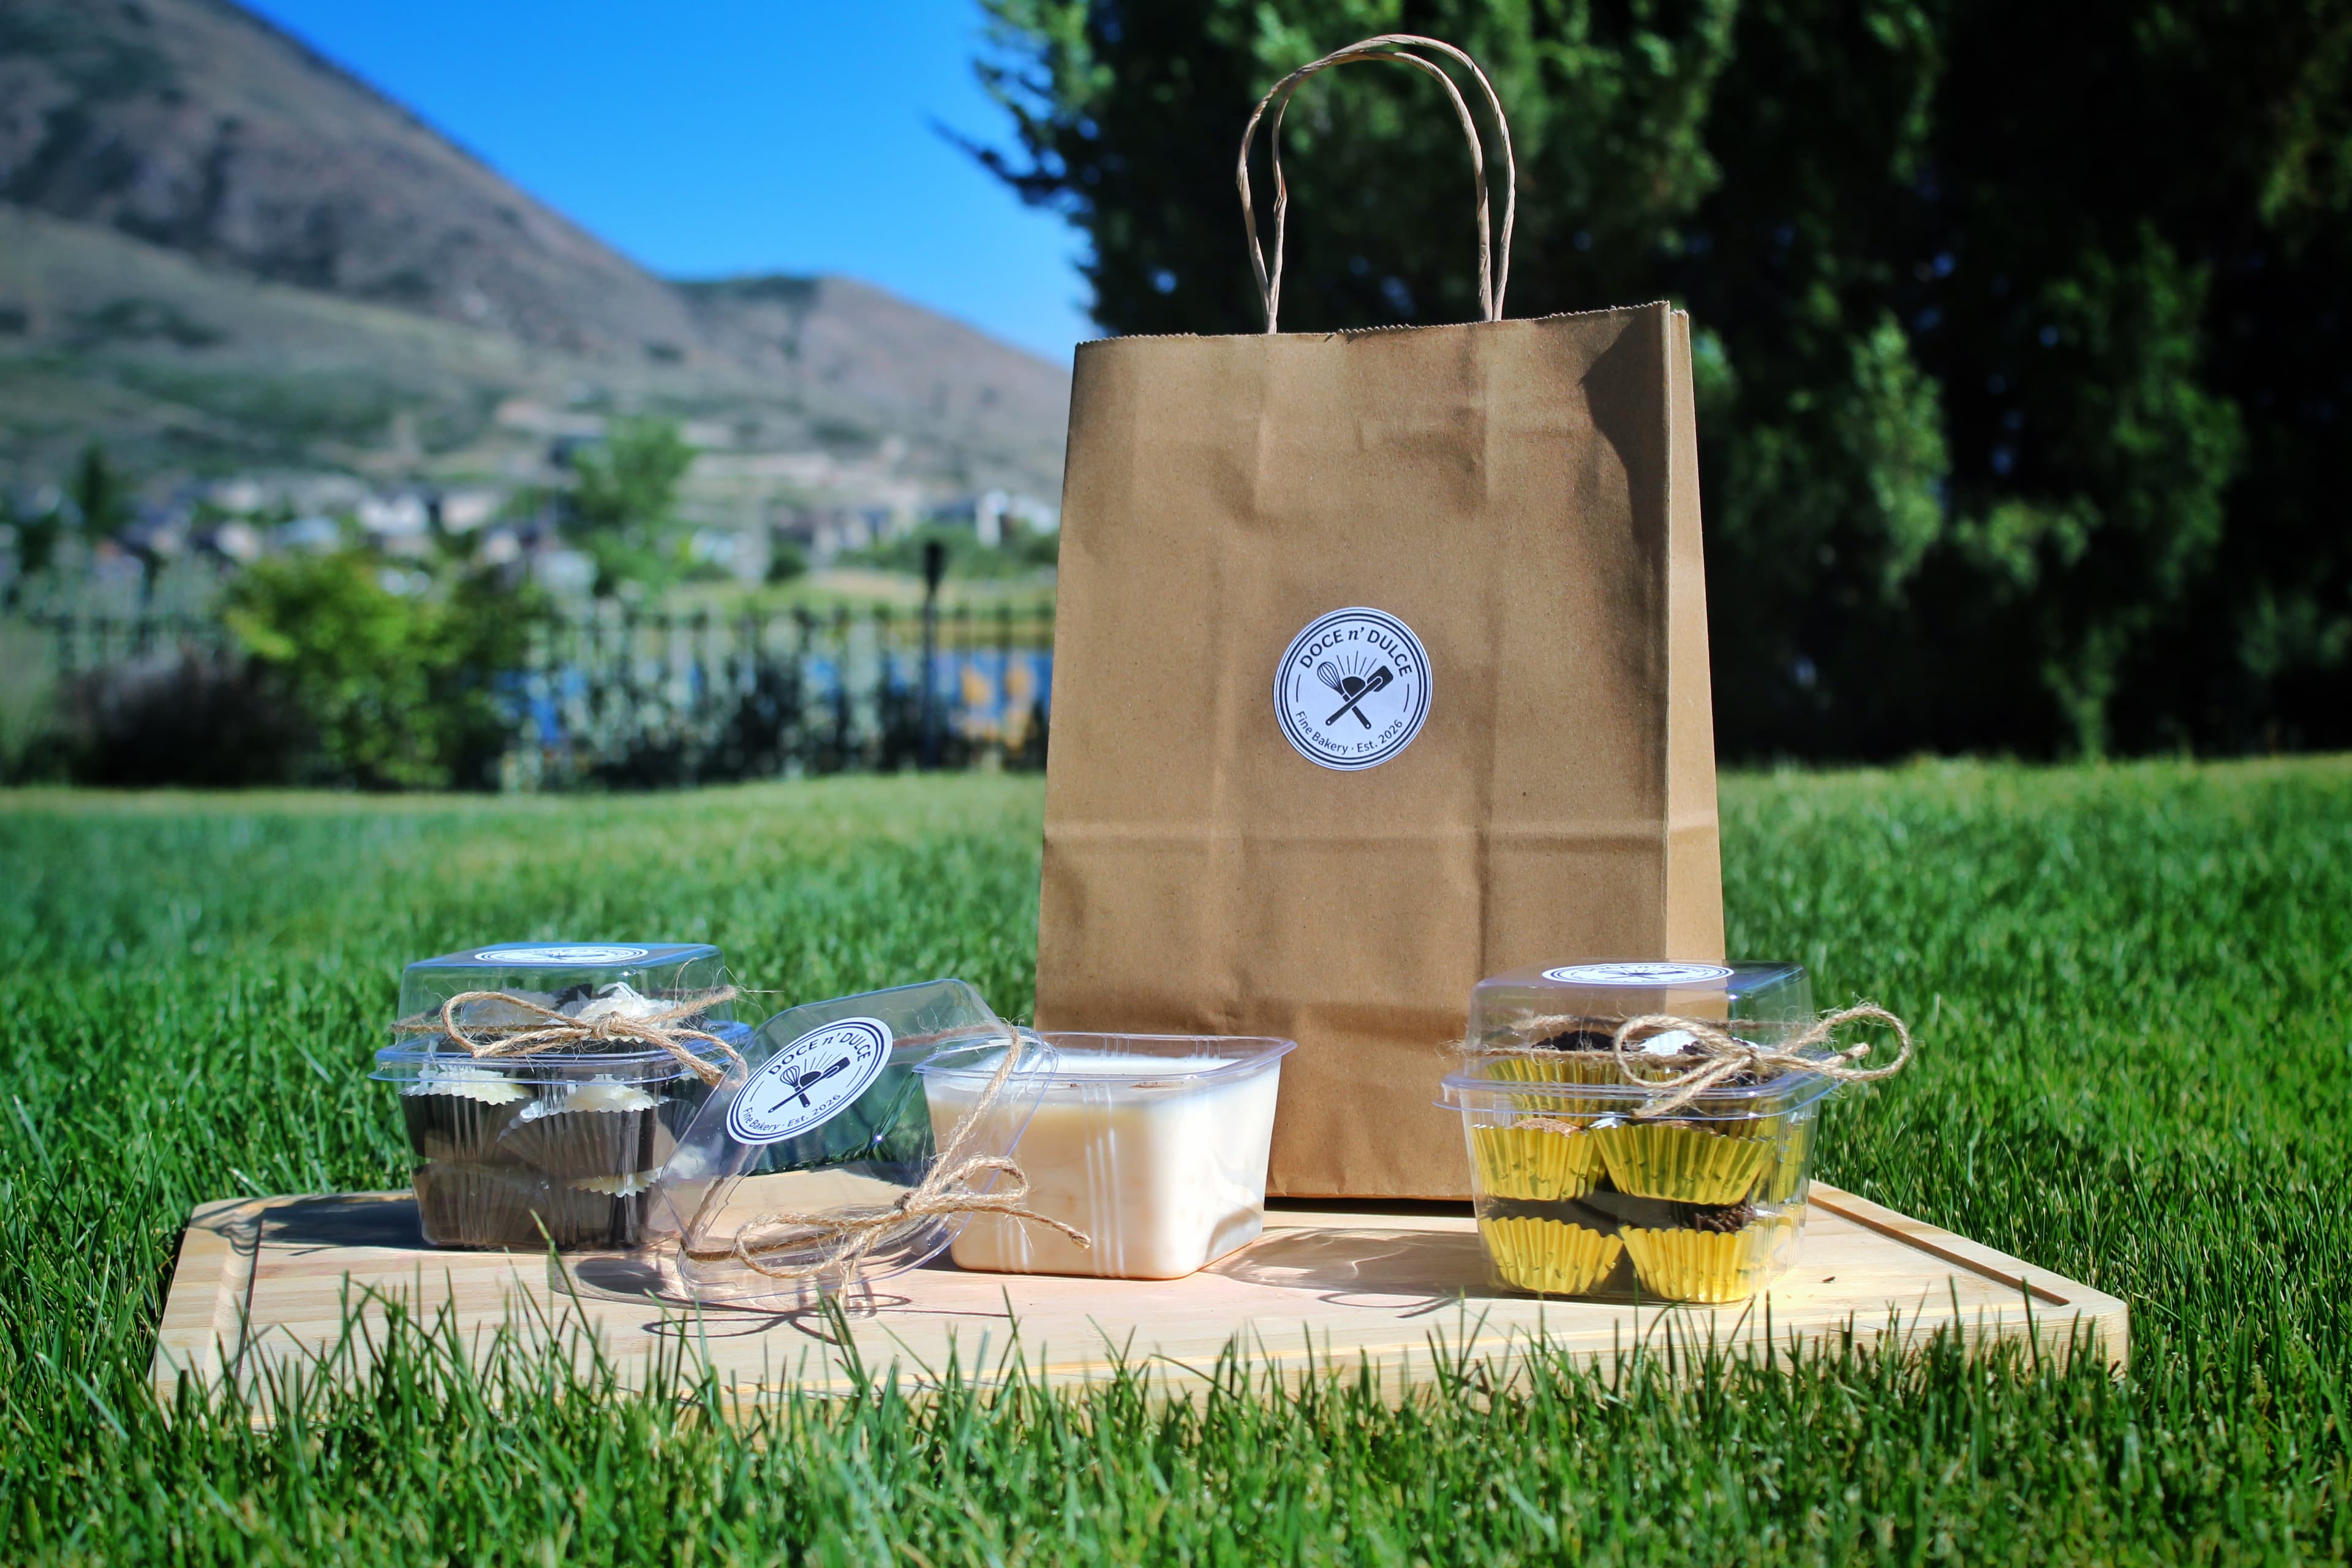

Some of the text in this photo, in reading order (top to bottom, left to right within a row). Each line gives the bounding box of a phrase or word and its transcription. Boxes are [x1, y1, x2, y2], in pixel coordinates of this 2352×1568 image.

[1300, 629, 1344, 669] DOCE
[1367, 630, 1412, 677] DULCE
[1295, 710, 1403, 755] Fine Bakery Est. 2026
[768, 1039, 818, 1075] DOCE
[839, 1033, 872, 1062] DULCE
[743, 1094, 841, 1133] Fine Bakery Est. 2026
